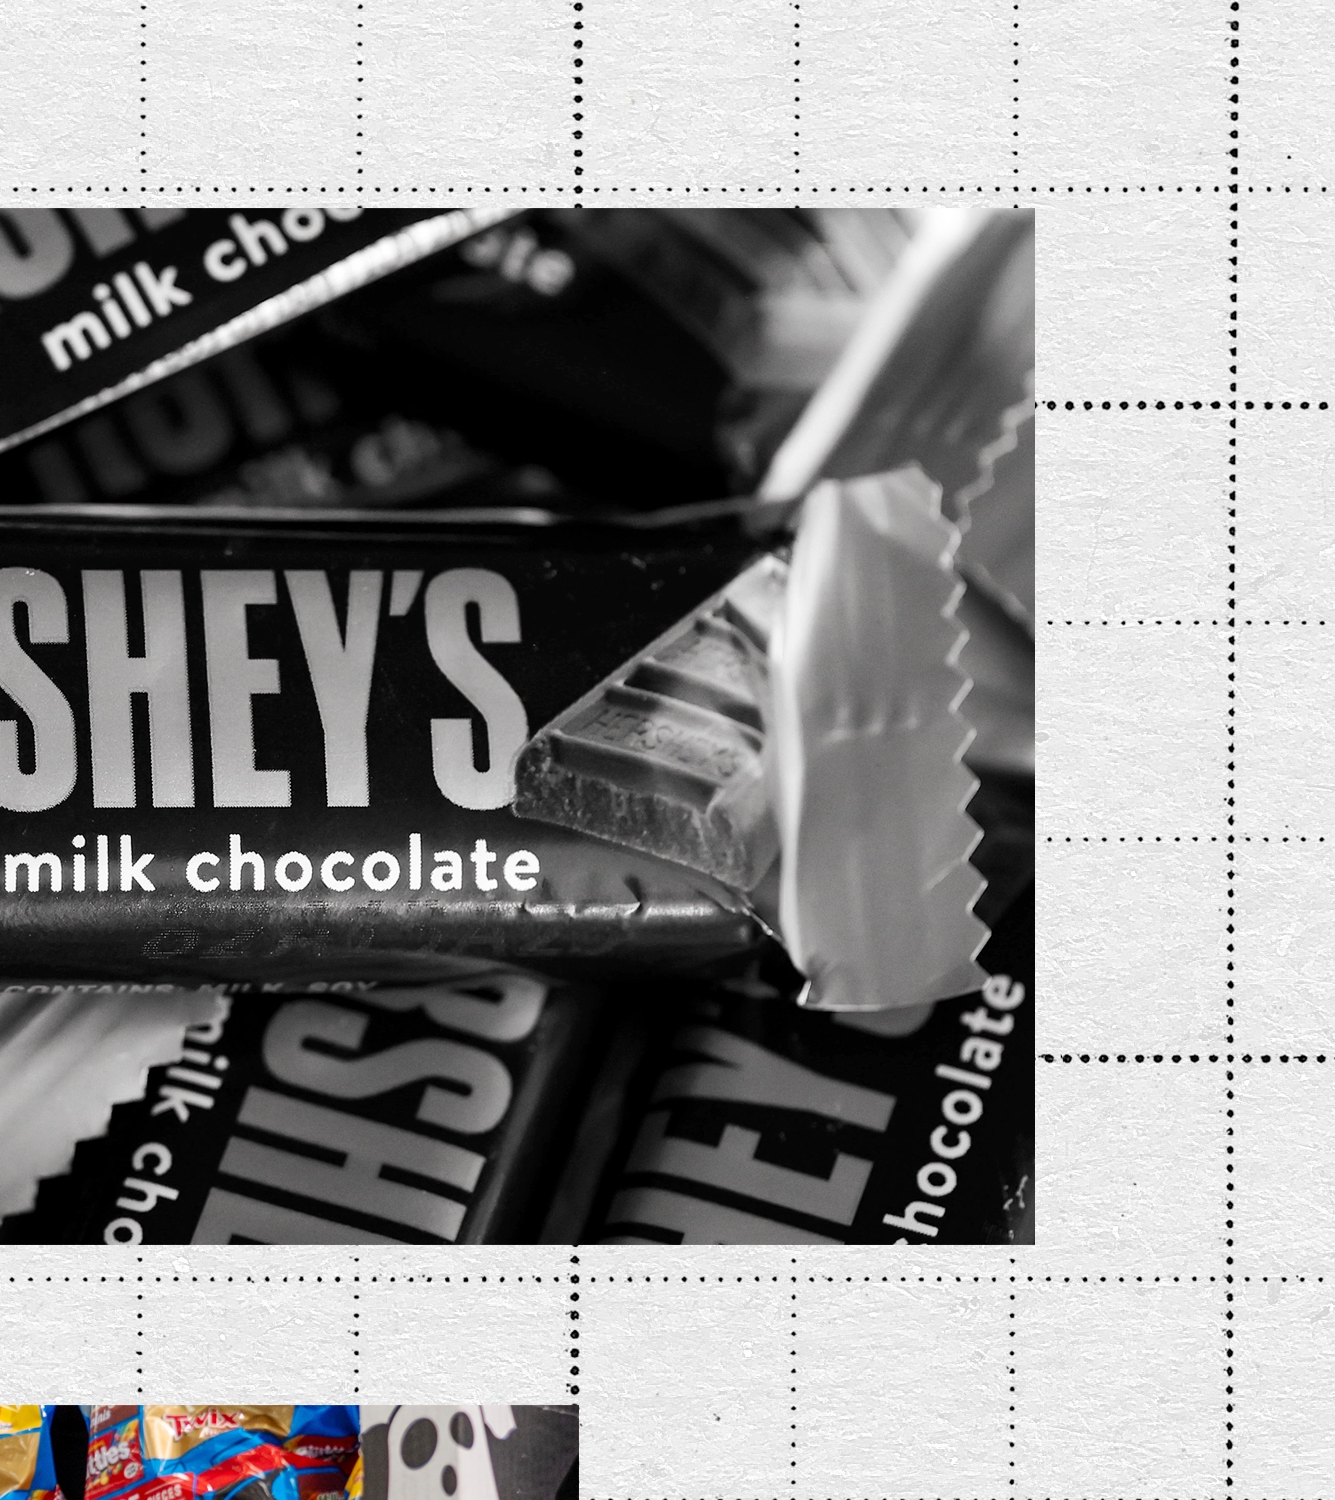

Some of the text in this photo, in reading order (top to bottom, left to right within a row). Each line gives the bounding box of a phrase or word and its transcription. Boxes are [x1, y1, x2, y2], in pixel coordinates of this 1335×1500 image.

[41, 260, 193, 372] milk
[4, 833, 541, 892] milk chocolate
[882, 974, 1026, 1245] hocolate
